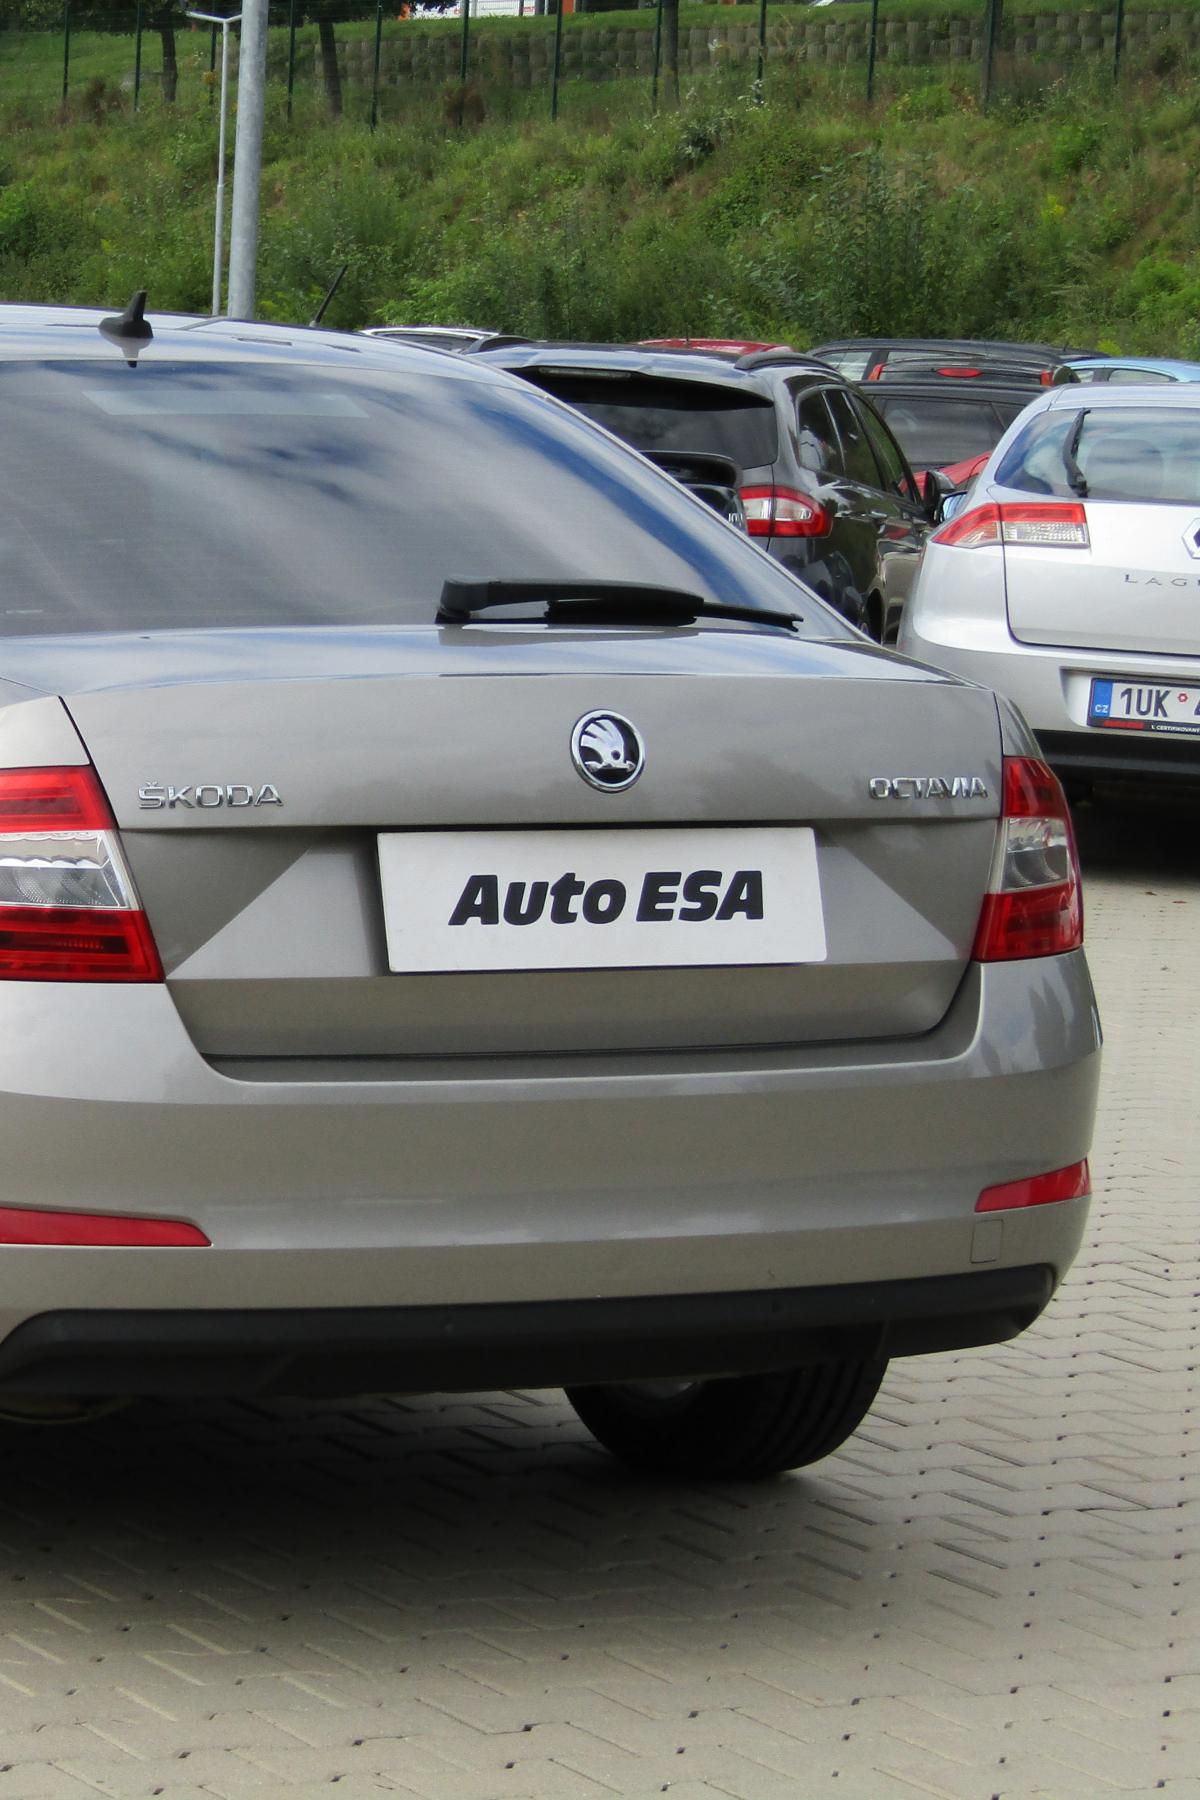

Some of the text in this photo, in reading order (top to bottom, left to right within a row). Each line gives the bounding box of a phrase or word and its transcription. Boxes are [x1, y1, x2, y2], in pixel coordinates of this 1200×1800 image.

[1124, 574, 1200, 587] LAG
[1094, 704, 1109, 713] CZ
[1120, 687, 1171, 718] 1UK
[138, 781, 284, 809] ŠKODA
[869, 777, 988, 799] OCTAVIA
[448, 870, 764, 926] Auto ESA
